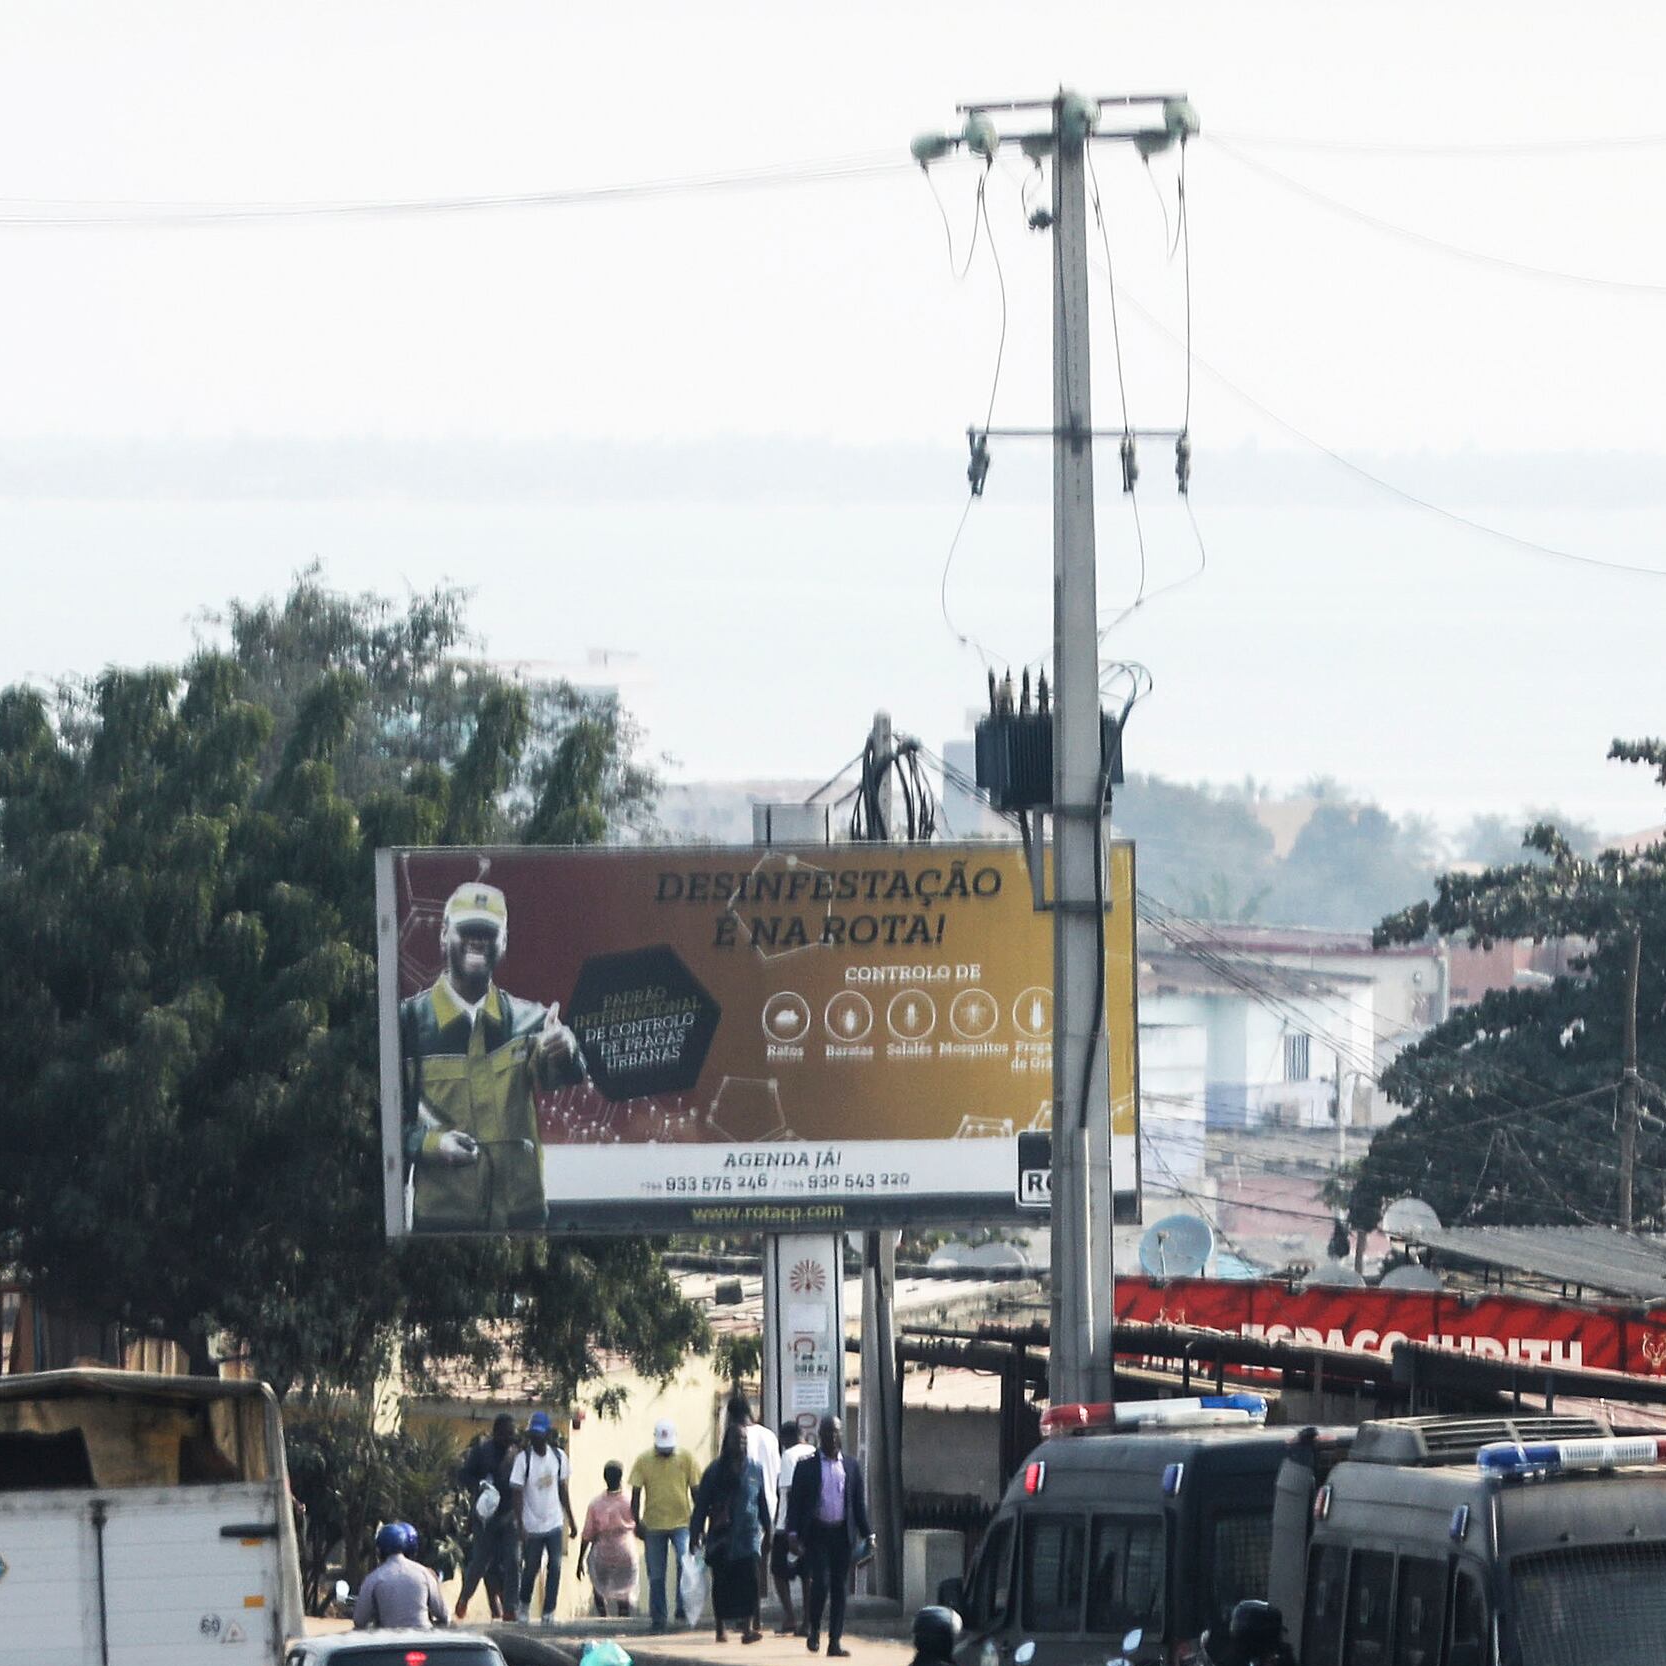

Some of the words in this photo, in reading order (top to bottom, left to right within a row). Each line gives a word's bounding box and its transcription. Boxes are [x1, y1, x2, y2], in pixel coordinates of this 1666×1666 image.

[654, 861, 1002, 908] DESINFESTAÇÃO
[752, 915, 808, 947] NA
[819, 913, 947, 946] ROTA!
[845, 964, 951, 983] CONTROLO
[956, 964, 982, 980] DE
[723, 1151, 810, 1168] AGENDA
[1028, 1172, 1053, 1193] R
